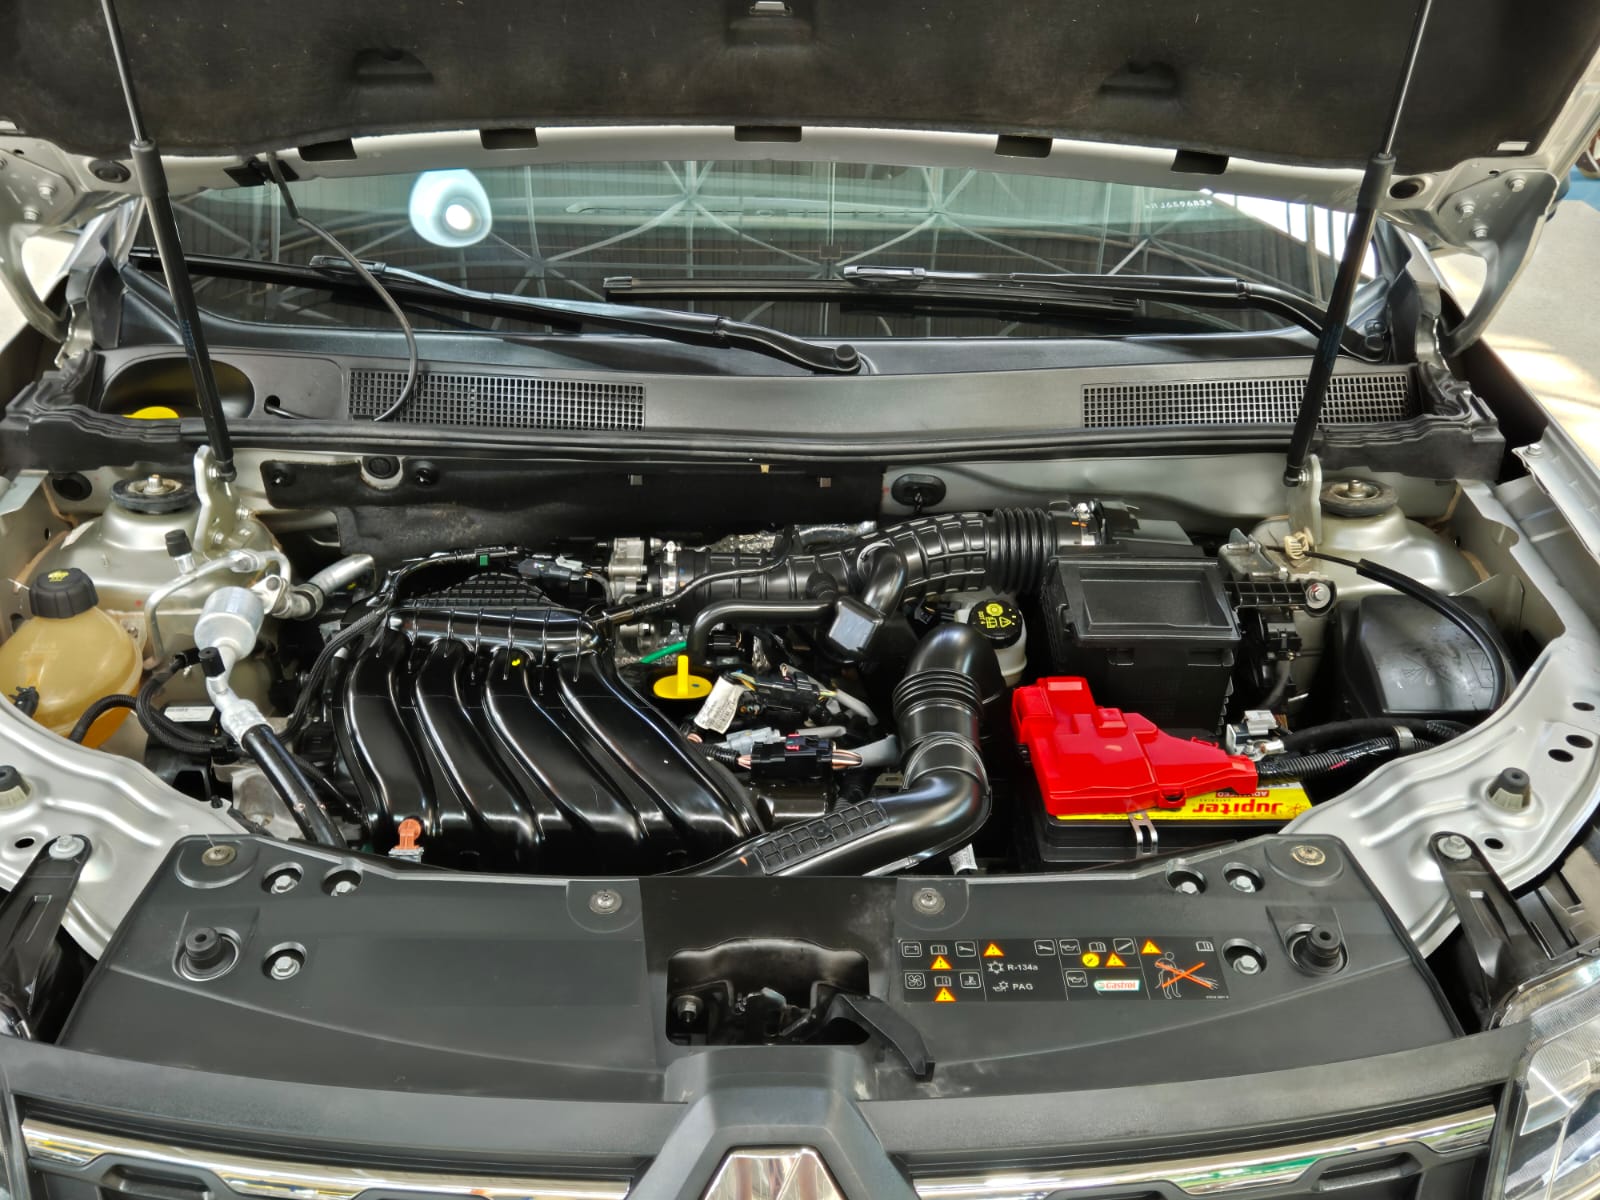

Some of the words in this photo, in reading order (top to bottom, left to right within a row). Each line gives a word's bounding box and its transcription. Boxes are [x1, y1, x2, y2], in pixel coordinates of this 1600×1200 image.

[1192, 799, 1283, 814] Jupiter
[1007, 963, 1039, 971] R-134a
[1012, 983, 1034, 991] PAG
[1105, 981, 1137, 989] Castrol
